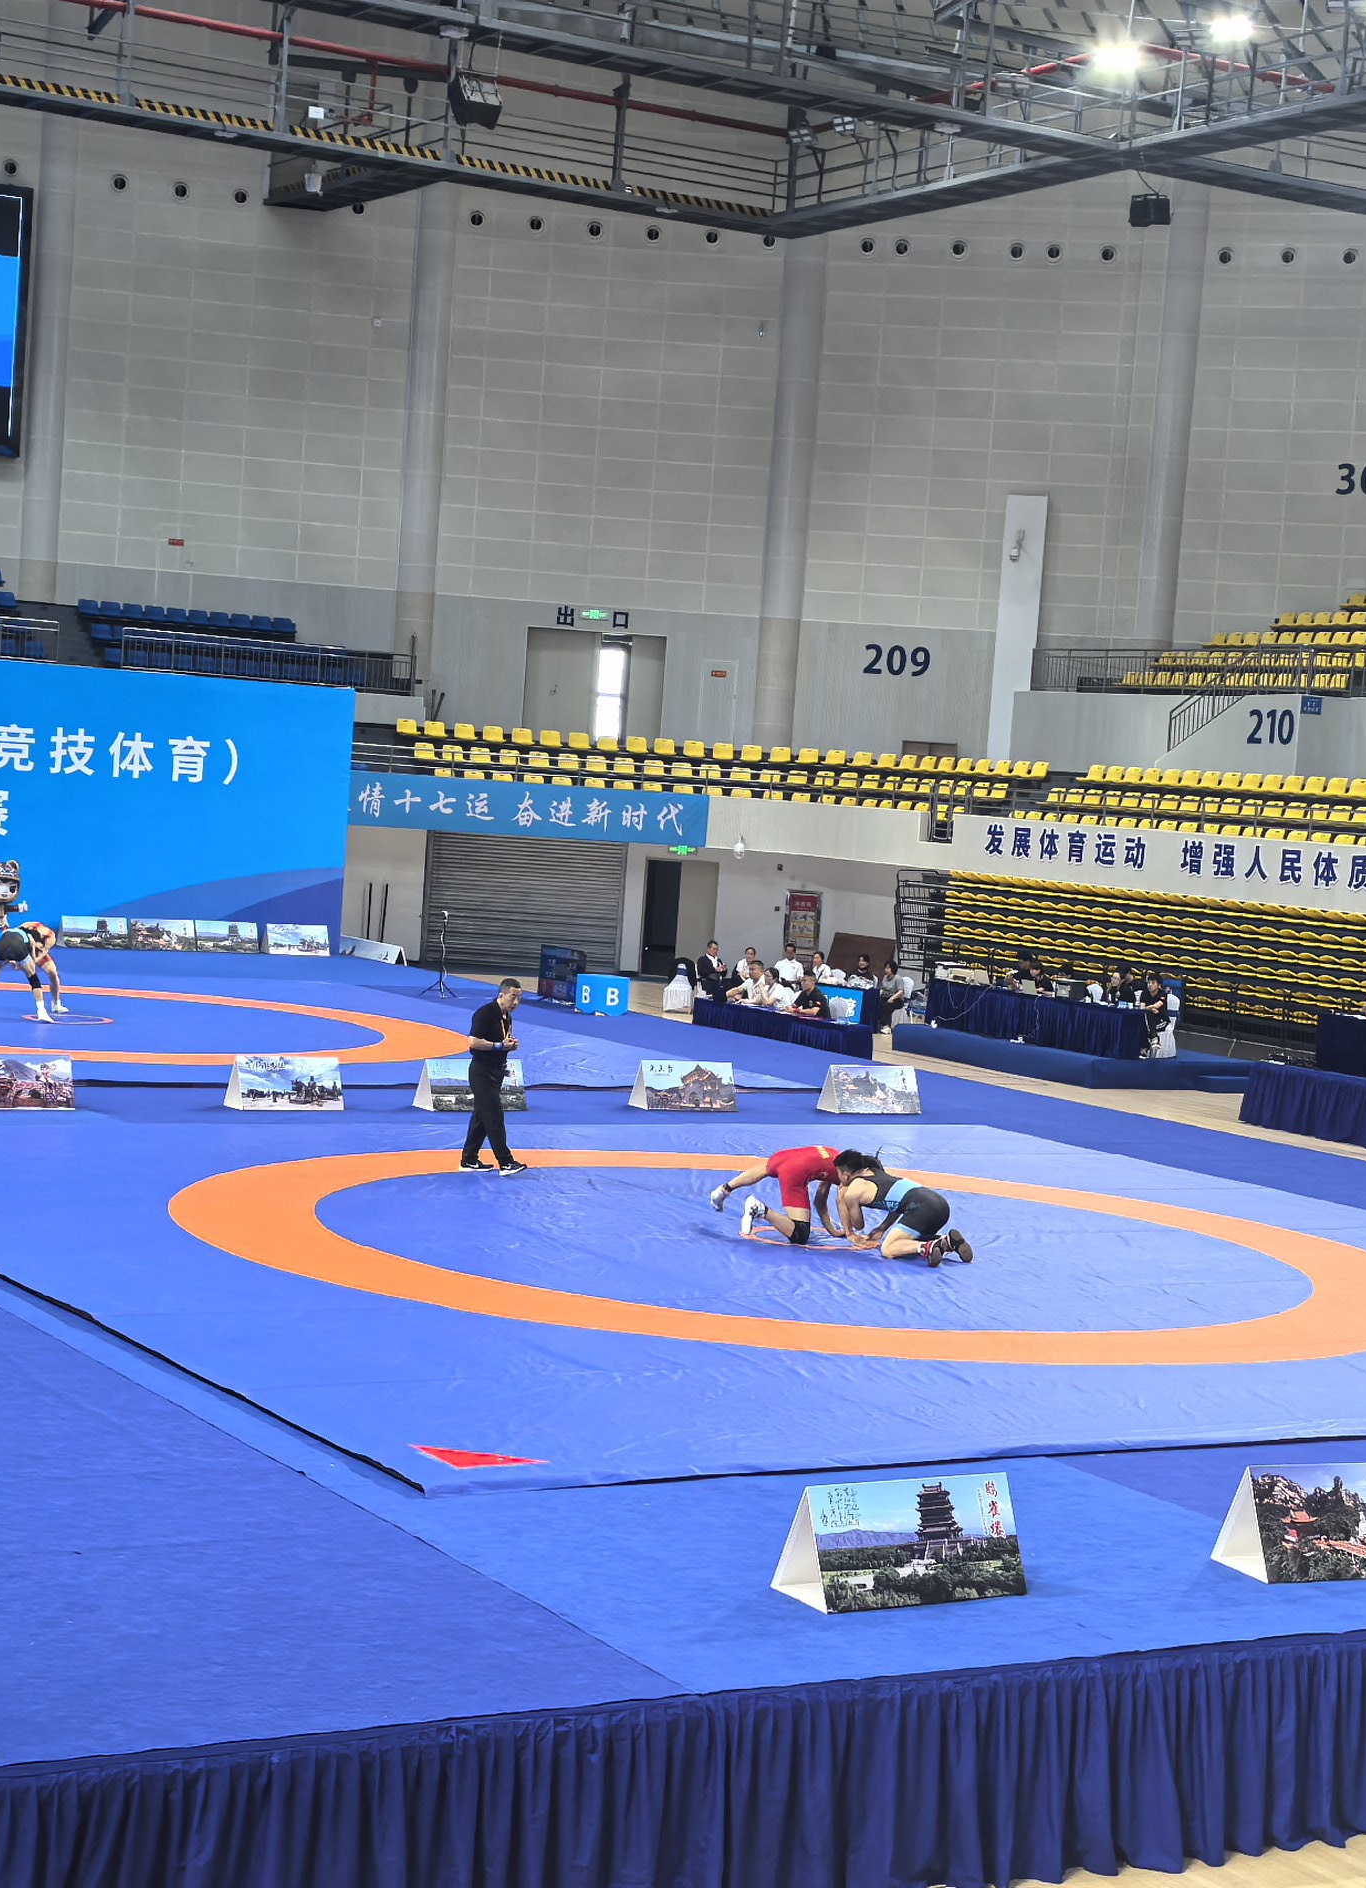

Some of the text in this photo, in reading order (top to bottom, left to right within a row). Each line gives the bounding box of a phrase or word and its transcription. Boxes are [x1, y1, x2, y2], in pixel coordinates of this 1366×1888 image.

[862, 643, 932, 677] 209
[1247, 709, 1295, 745] 210
[349, 780, 685, 837] 情十七运 奋进新时代
[985, 824, 1146, 870] 发展体育运动
[581, 985, 590, 1003] B
[606, 987, 619, 1006] B
